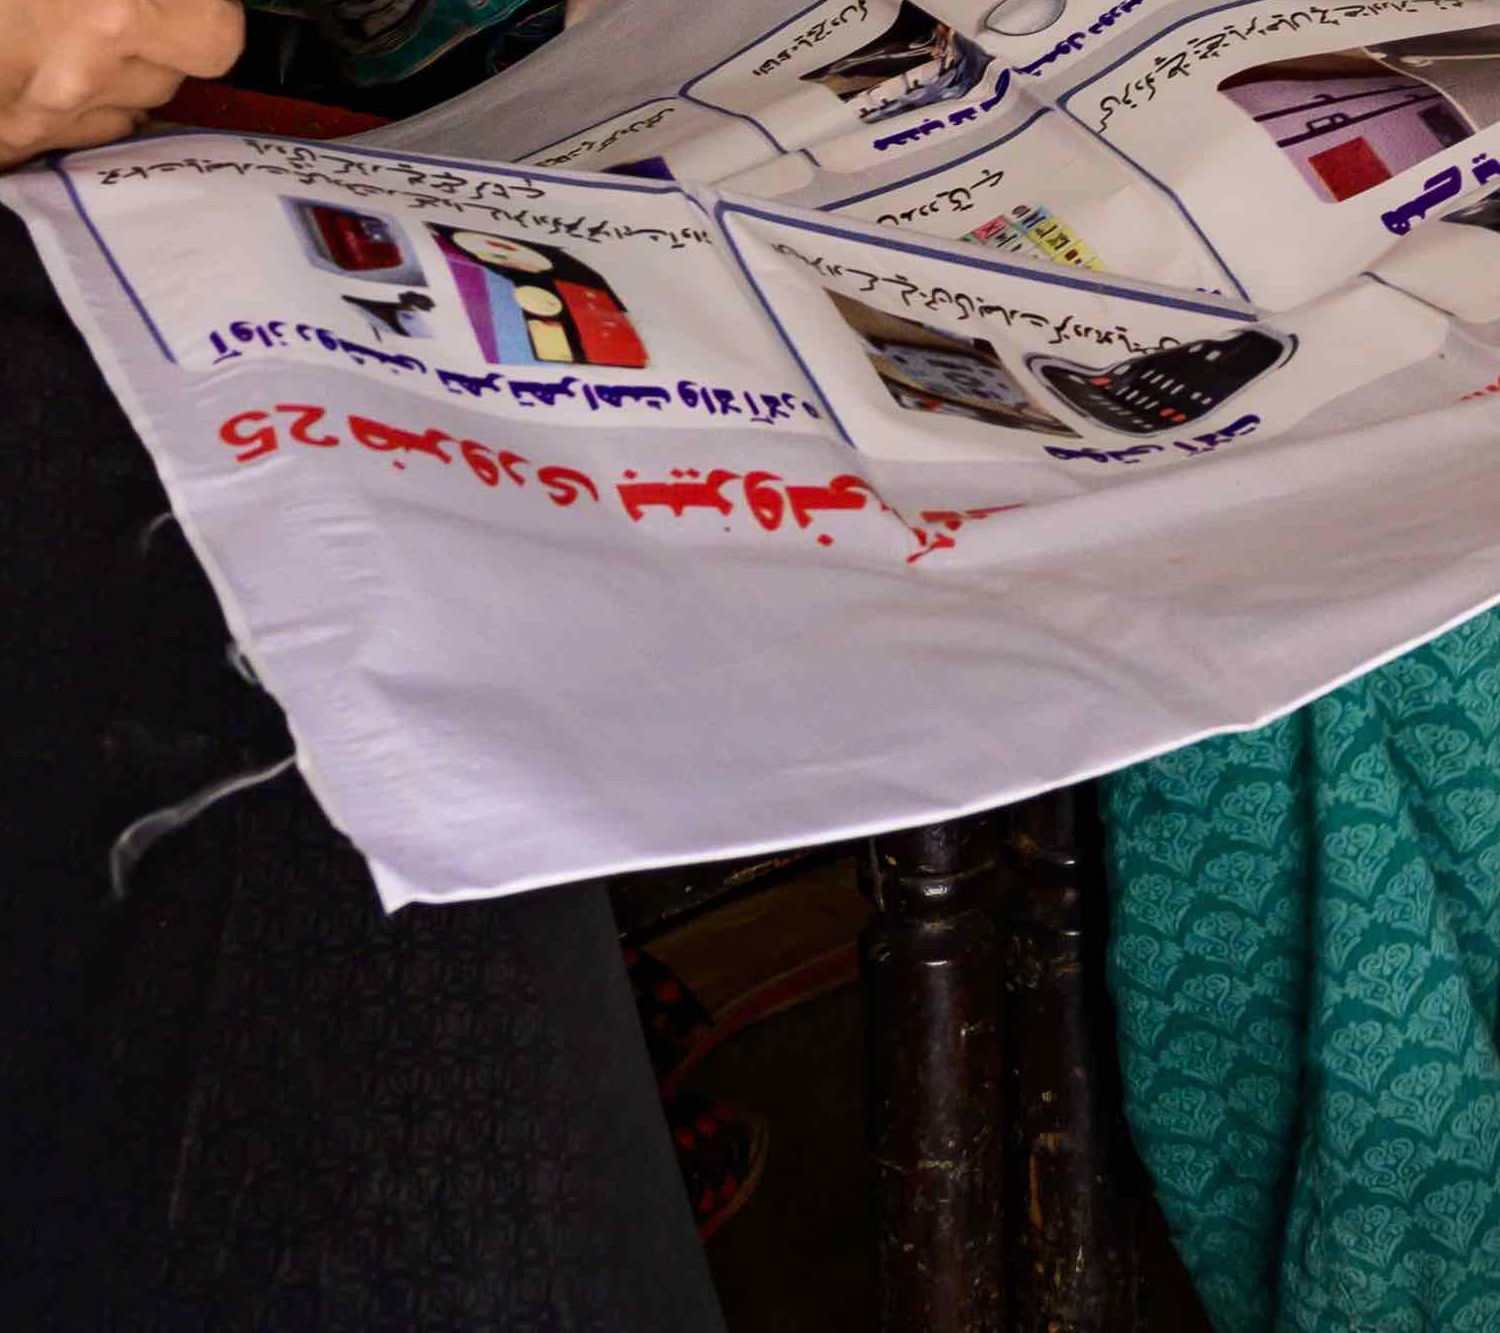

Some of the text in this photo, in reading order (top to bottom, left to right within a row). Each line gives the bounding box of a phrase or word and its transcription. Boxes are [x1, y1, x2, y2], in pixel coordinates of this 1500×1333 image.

[208, 320, 287, 364] آواز
[295, 324, 427, 377] روشنی
[677, 380, 741, 415] والا
[219, 403, 340, 462] 25
[347, 413, 598, 509] ضروری
